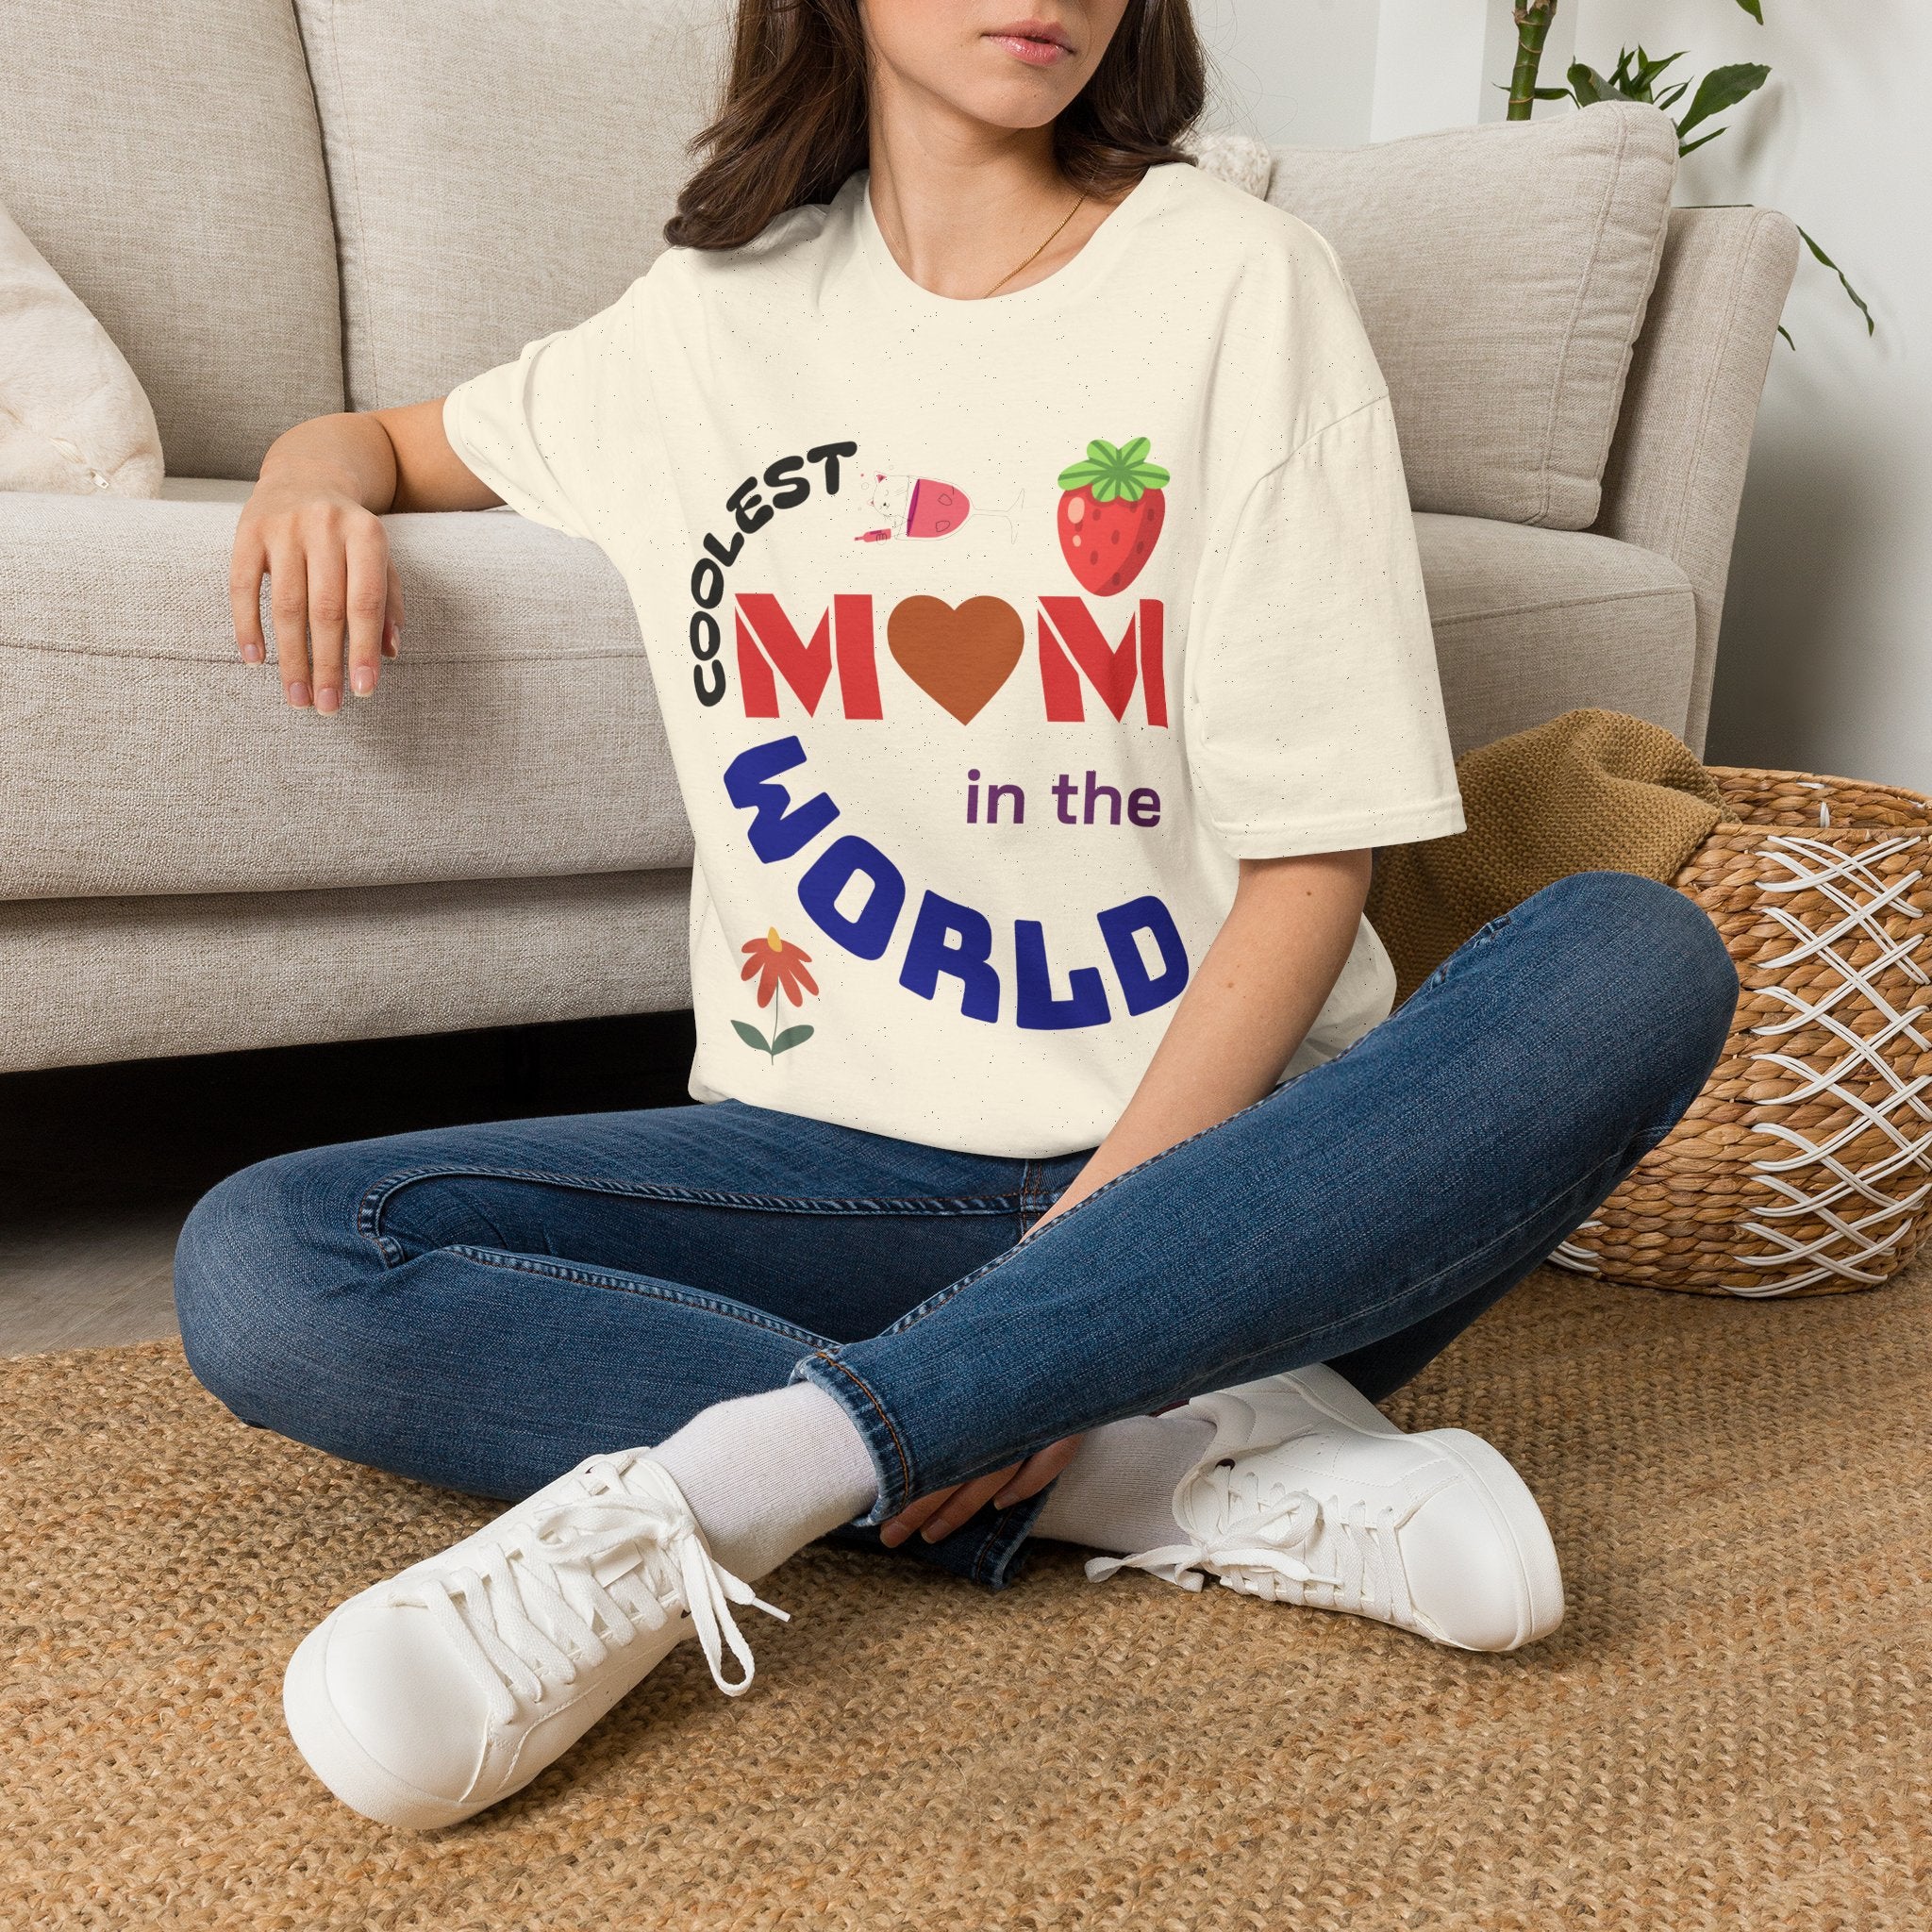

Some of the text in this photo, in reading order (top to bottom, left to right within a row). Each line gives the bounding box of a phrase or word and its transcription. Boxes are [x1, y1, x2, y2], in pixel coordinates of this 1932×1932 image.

[690, 441, 858, 708] COOLEST
[724, 735, 1190, 1030] WORLD
[966, 769, 1161, 827] in the
